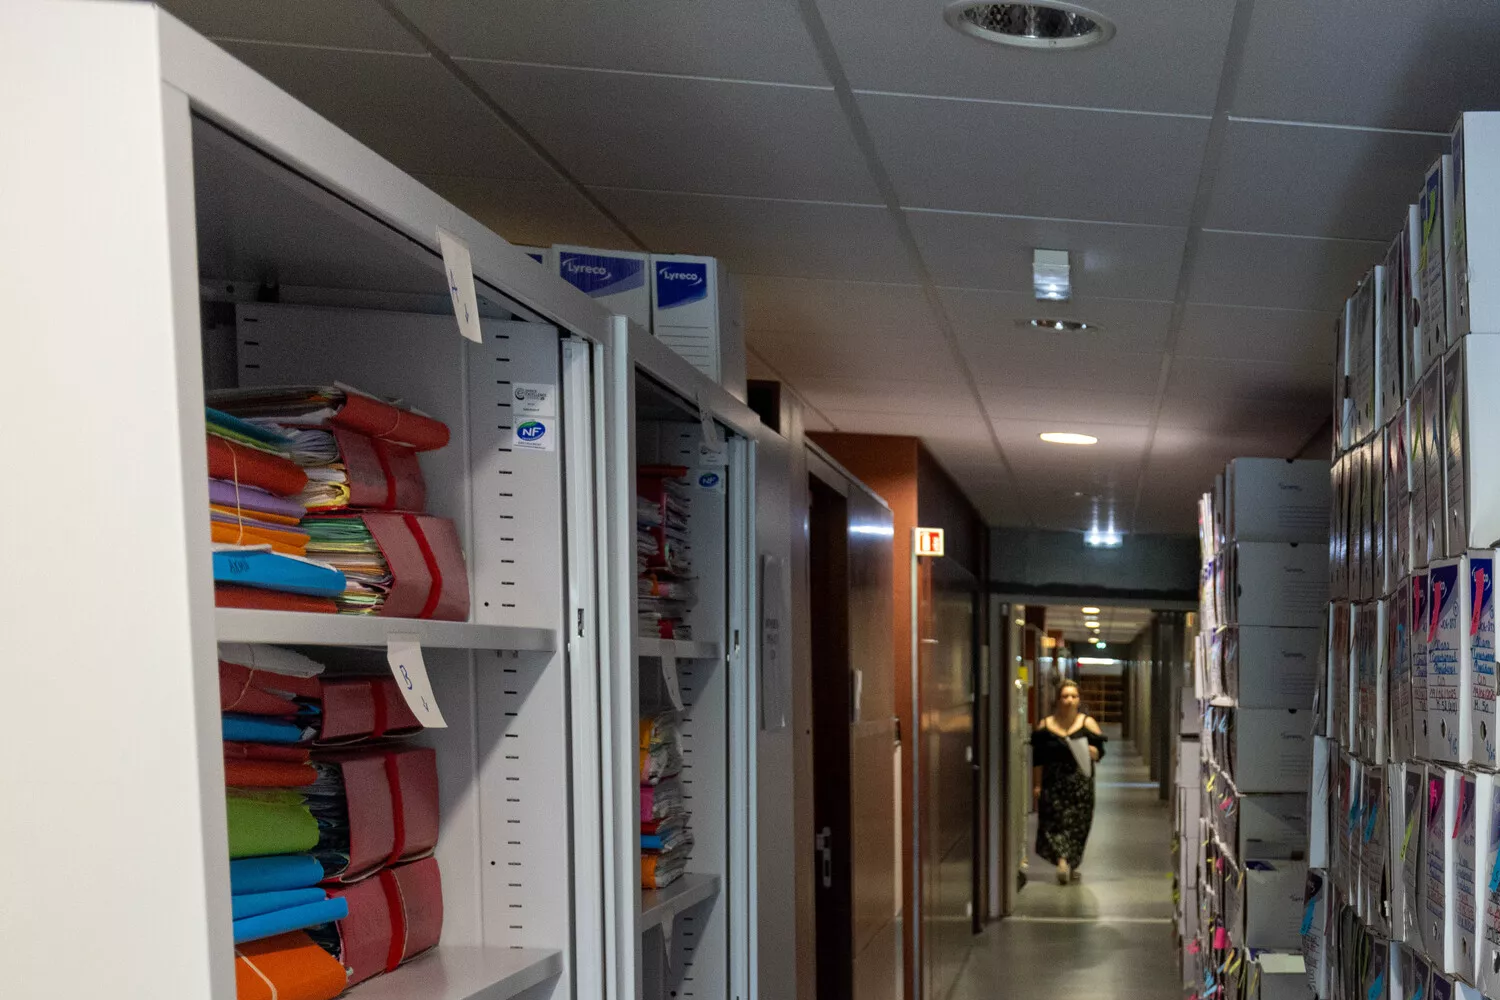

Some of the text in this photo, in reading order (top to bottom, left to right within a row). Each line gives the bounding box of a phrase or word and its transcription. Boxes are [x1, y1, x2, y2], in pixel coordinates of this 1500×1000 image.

[567, 264, 607, 275] Lyreco
[664, 271, 698, 281] Lyreco
[522, 427, 542, 437] NF
